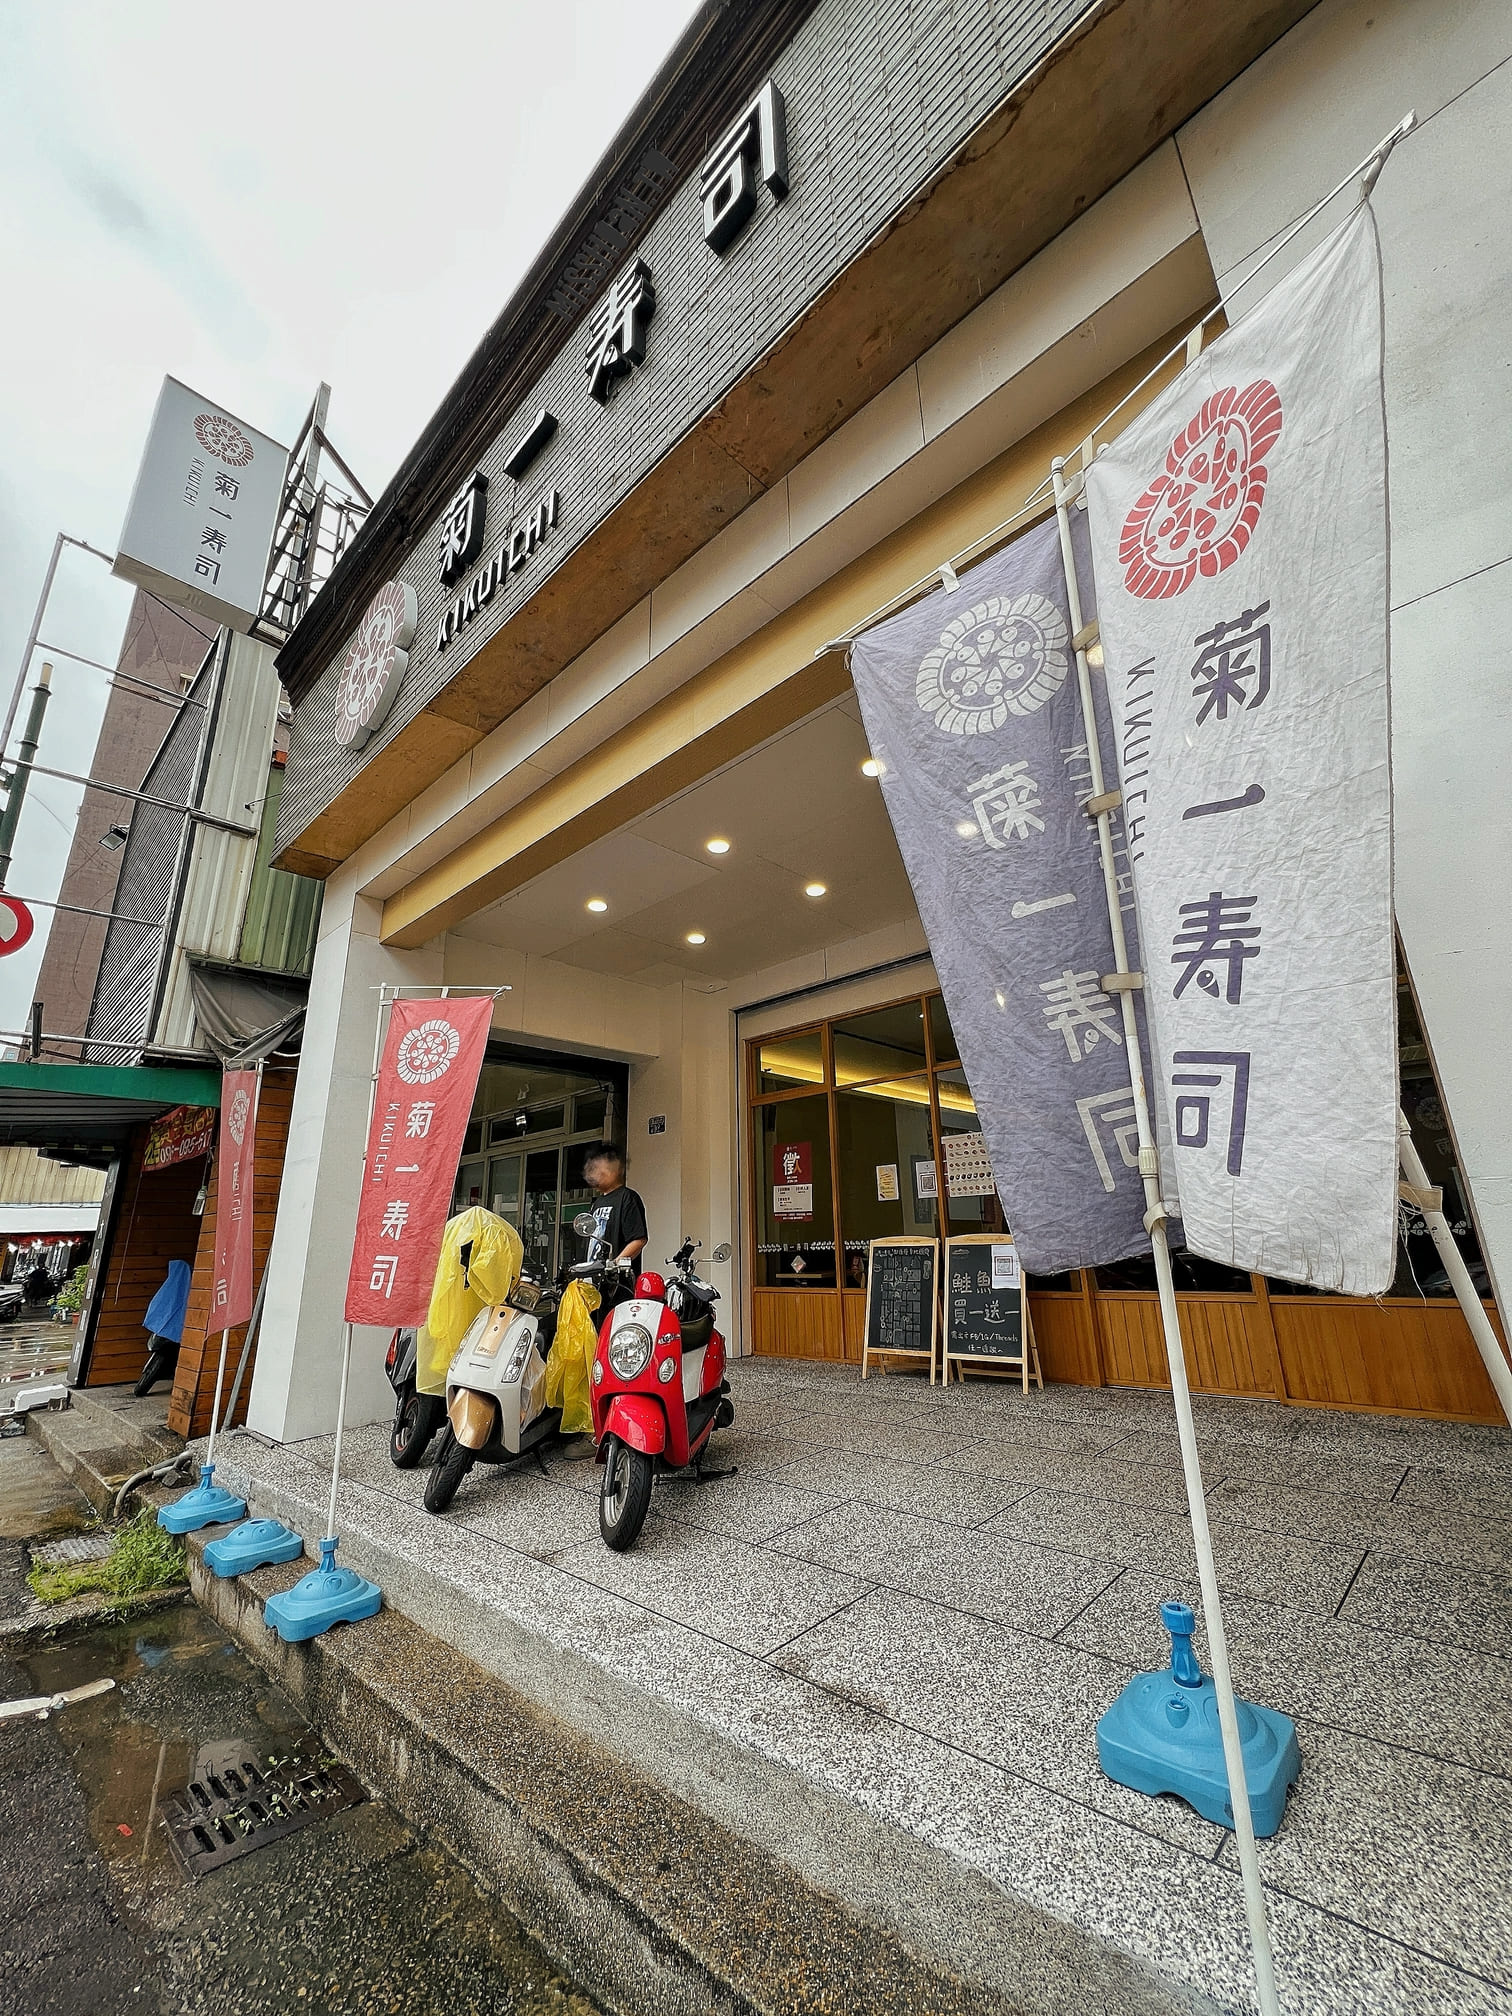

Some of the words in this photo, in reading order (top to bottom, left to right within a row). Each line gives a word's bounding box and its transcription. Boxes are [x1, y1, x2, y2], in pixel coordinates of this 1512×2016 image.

[438, 78, 790, 588] 菊一寿司
[183, 457, 205, 507] KIKUICHI
[194, 471, 240, 585] 菊一寿司
[437, 489, 559, 652] KIKUICHI
[1123, 656, 1156, 862] KIKUICHI
[1170, 599, 1272, 1177] 菊一寿司
[369, 1101, 436, 1299] 菊一寿司
[372, 1103, 401, 1182] KIKUICHI
[951, 1270, 992, 1294] 鮭魚
[954, 1298, 1020, 1325] 買一送一
